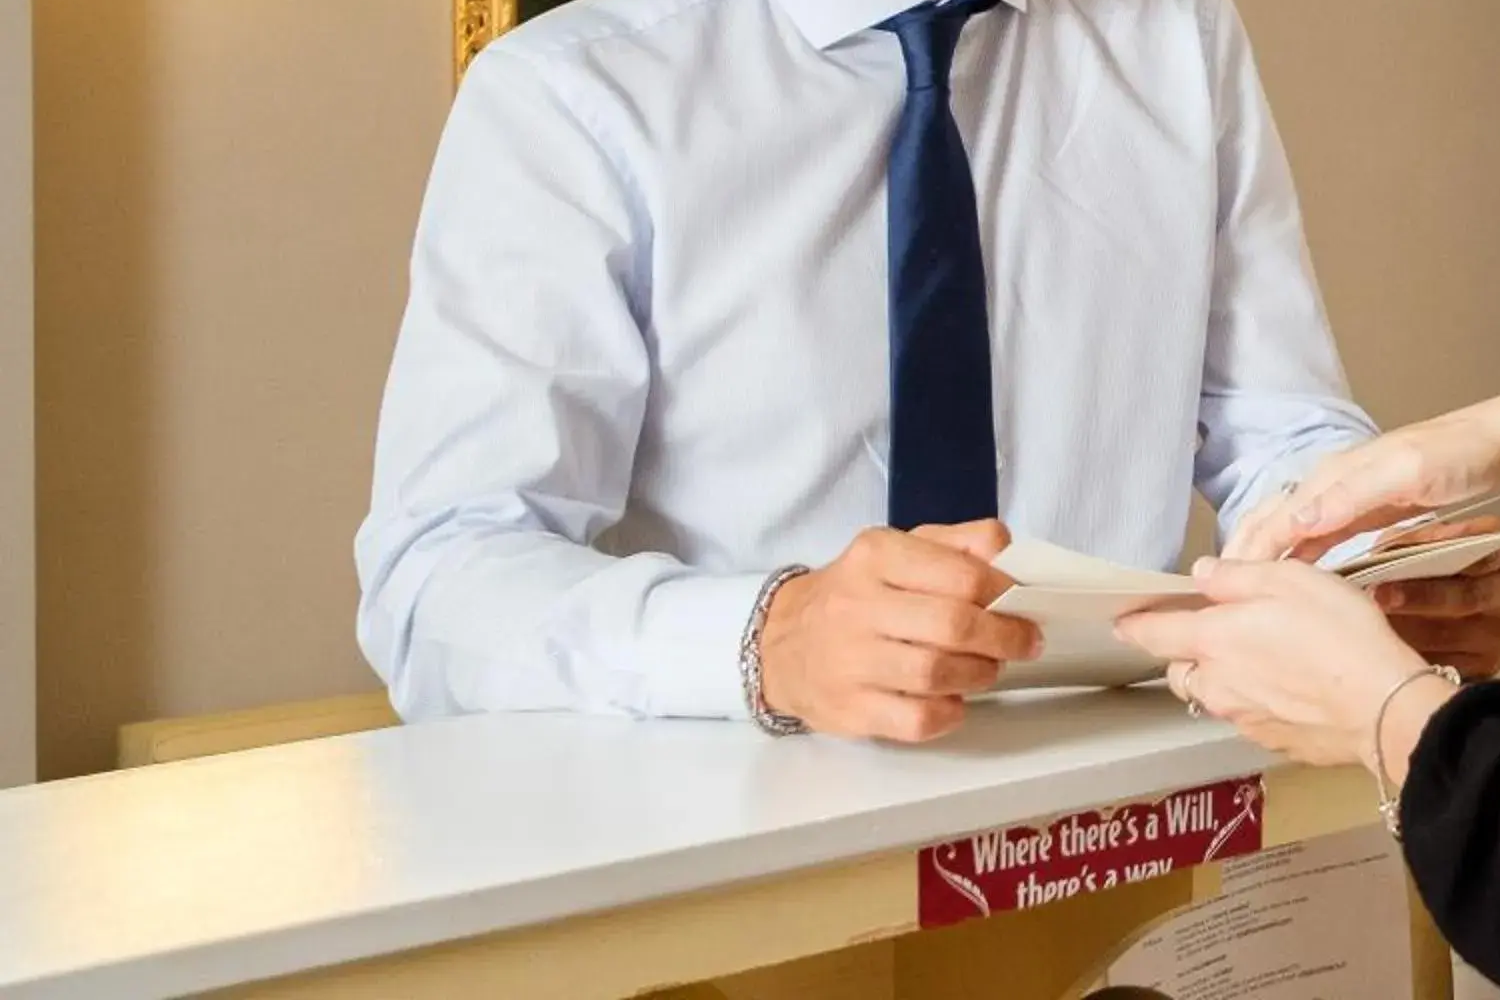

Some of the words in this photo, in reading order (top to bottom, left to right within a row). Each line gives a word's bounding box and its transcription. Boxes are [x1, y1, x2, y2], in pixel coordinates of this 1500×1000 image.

[971, 832, 1053, 875] Where
[1060, 811, 1137, 857] there's
[1145, 813, 1159, 840] a
[1165, 791, 1219, 837] Will,
[1104, 868, 1118, 889] a
